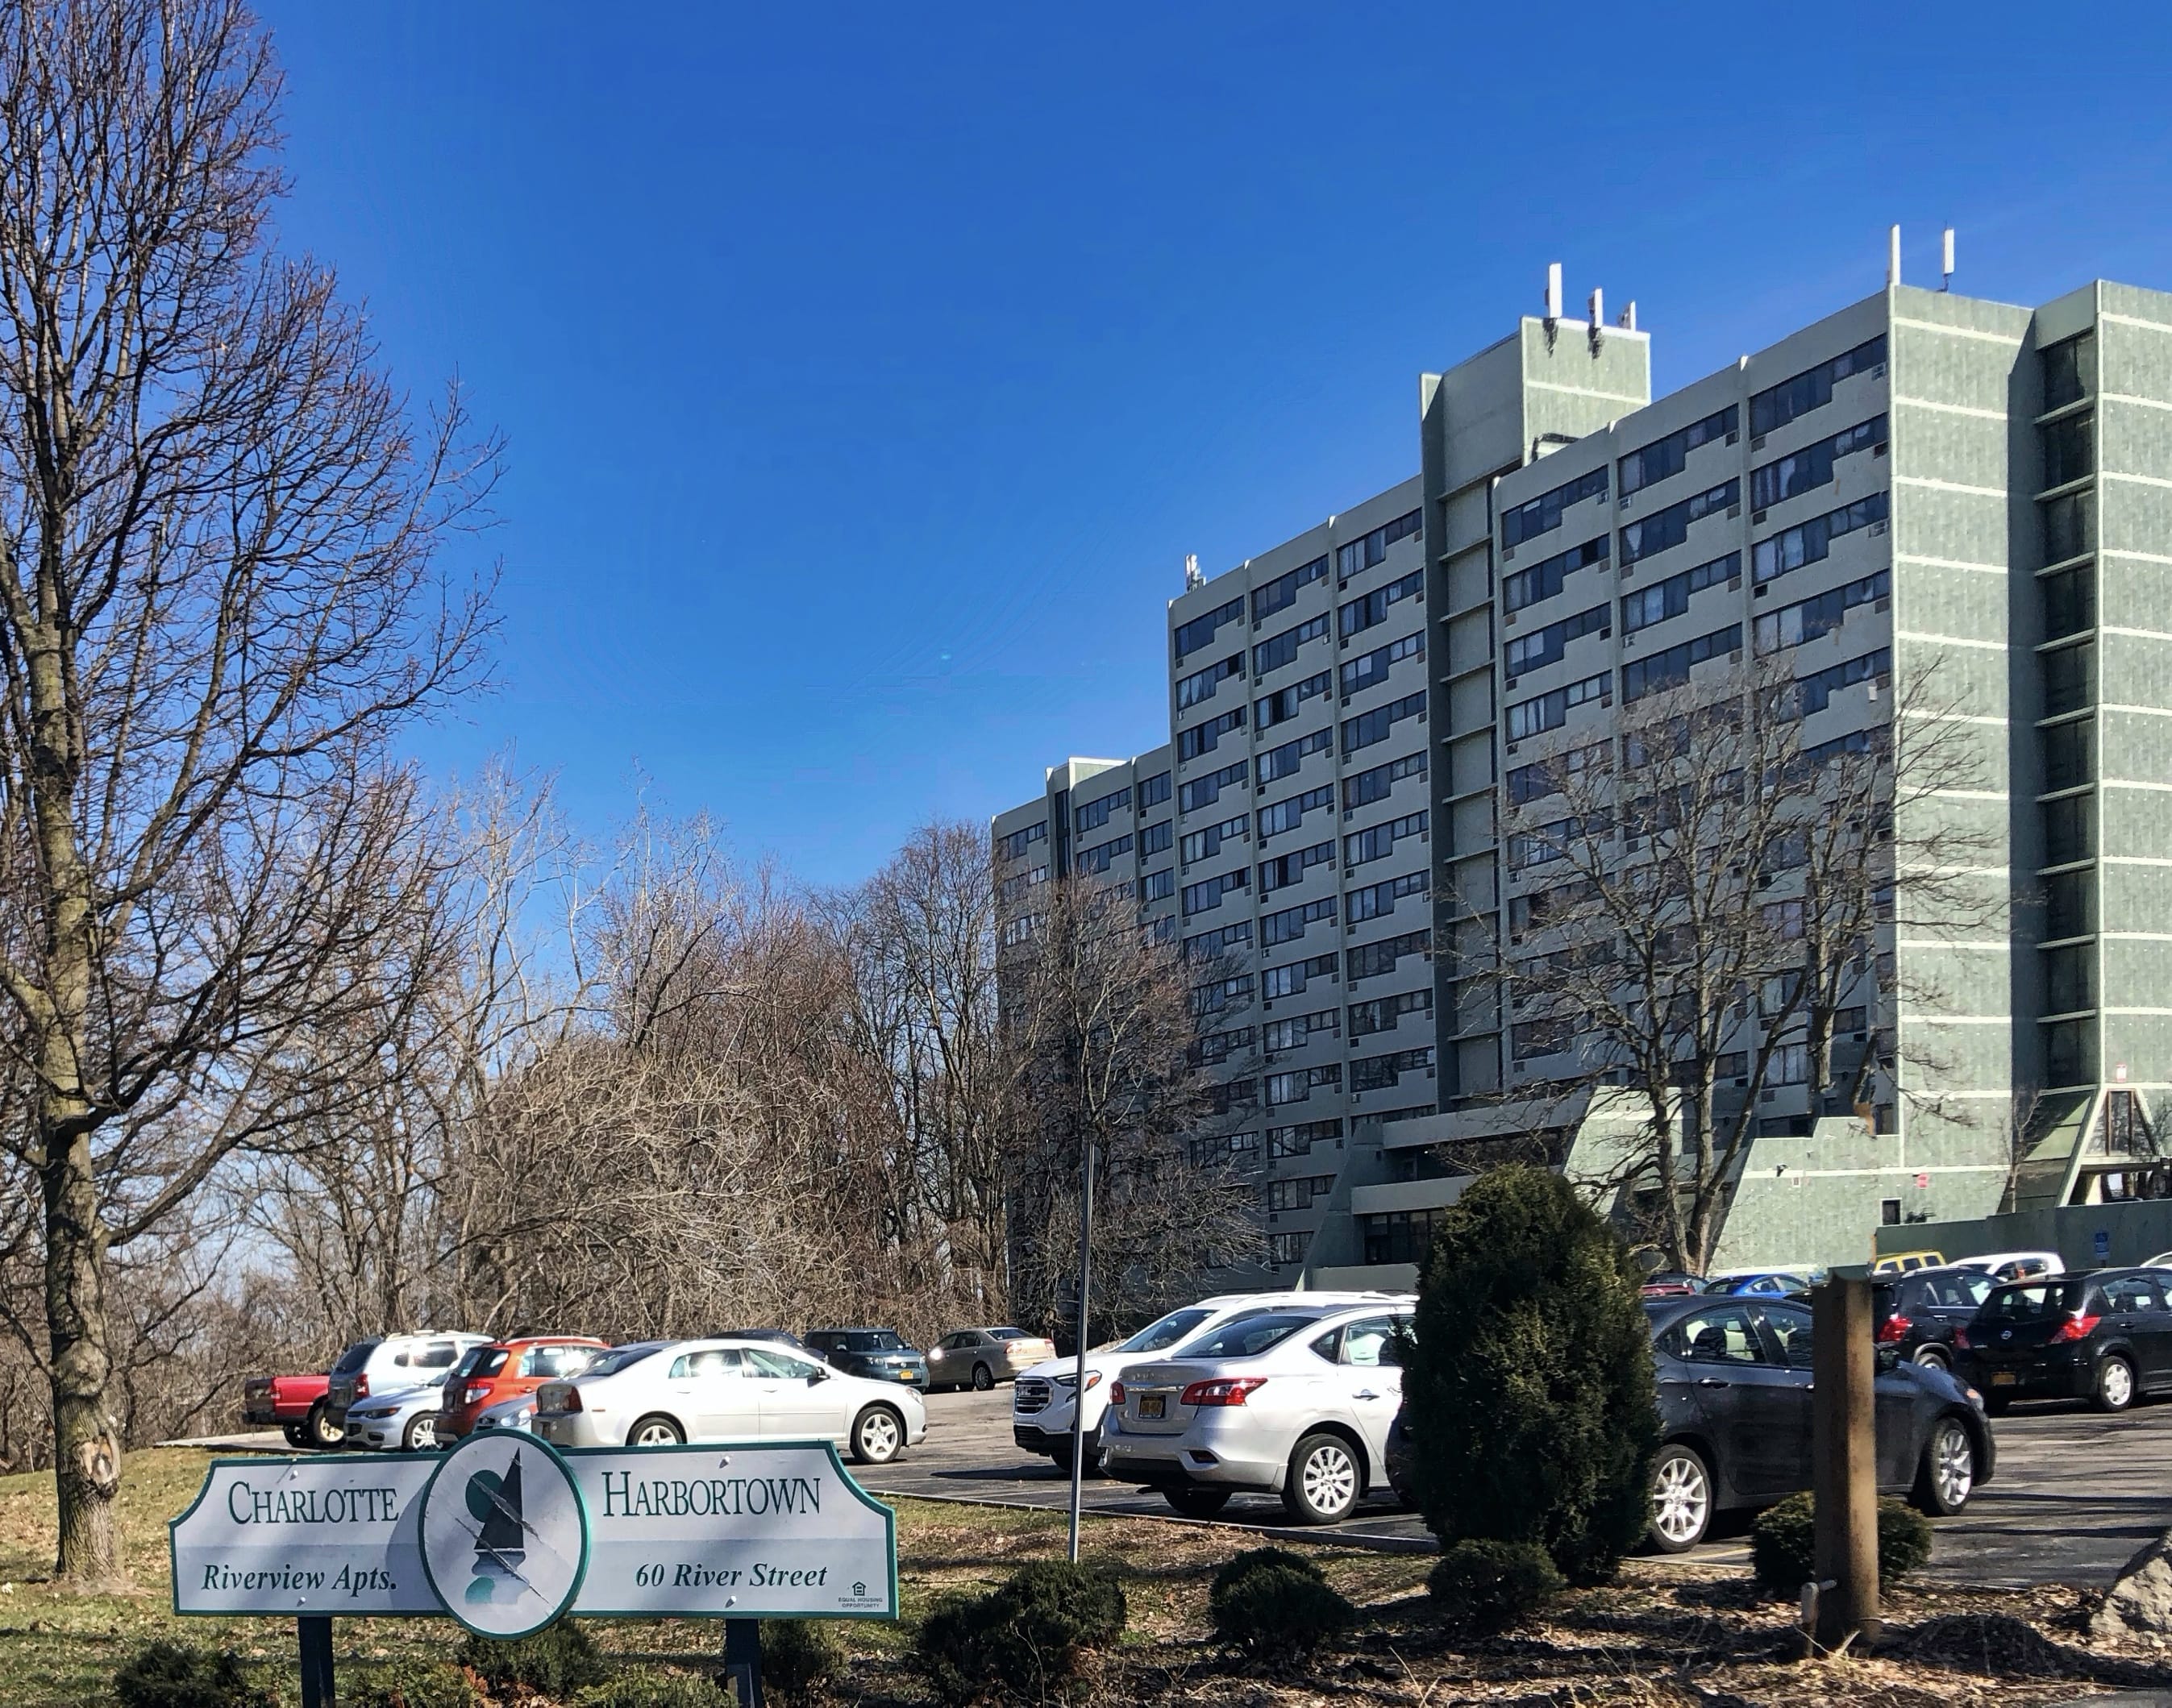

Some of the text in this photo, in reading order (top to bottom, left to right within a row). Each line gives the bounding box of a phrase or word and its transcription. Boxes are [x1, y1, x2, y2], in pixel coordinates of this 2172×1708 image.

[228, 1481, 399, 1524] CHARLOTTE
[601, 1471, 820, 1516] HARBORTOWN
[202, 1564, 397, 1597] Riverview Apts.
[636, 1563, 828, 1586] 60 River Street
